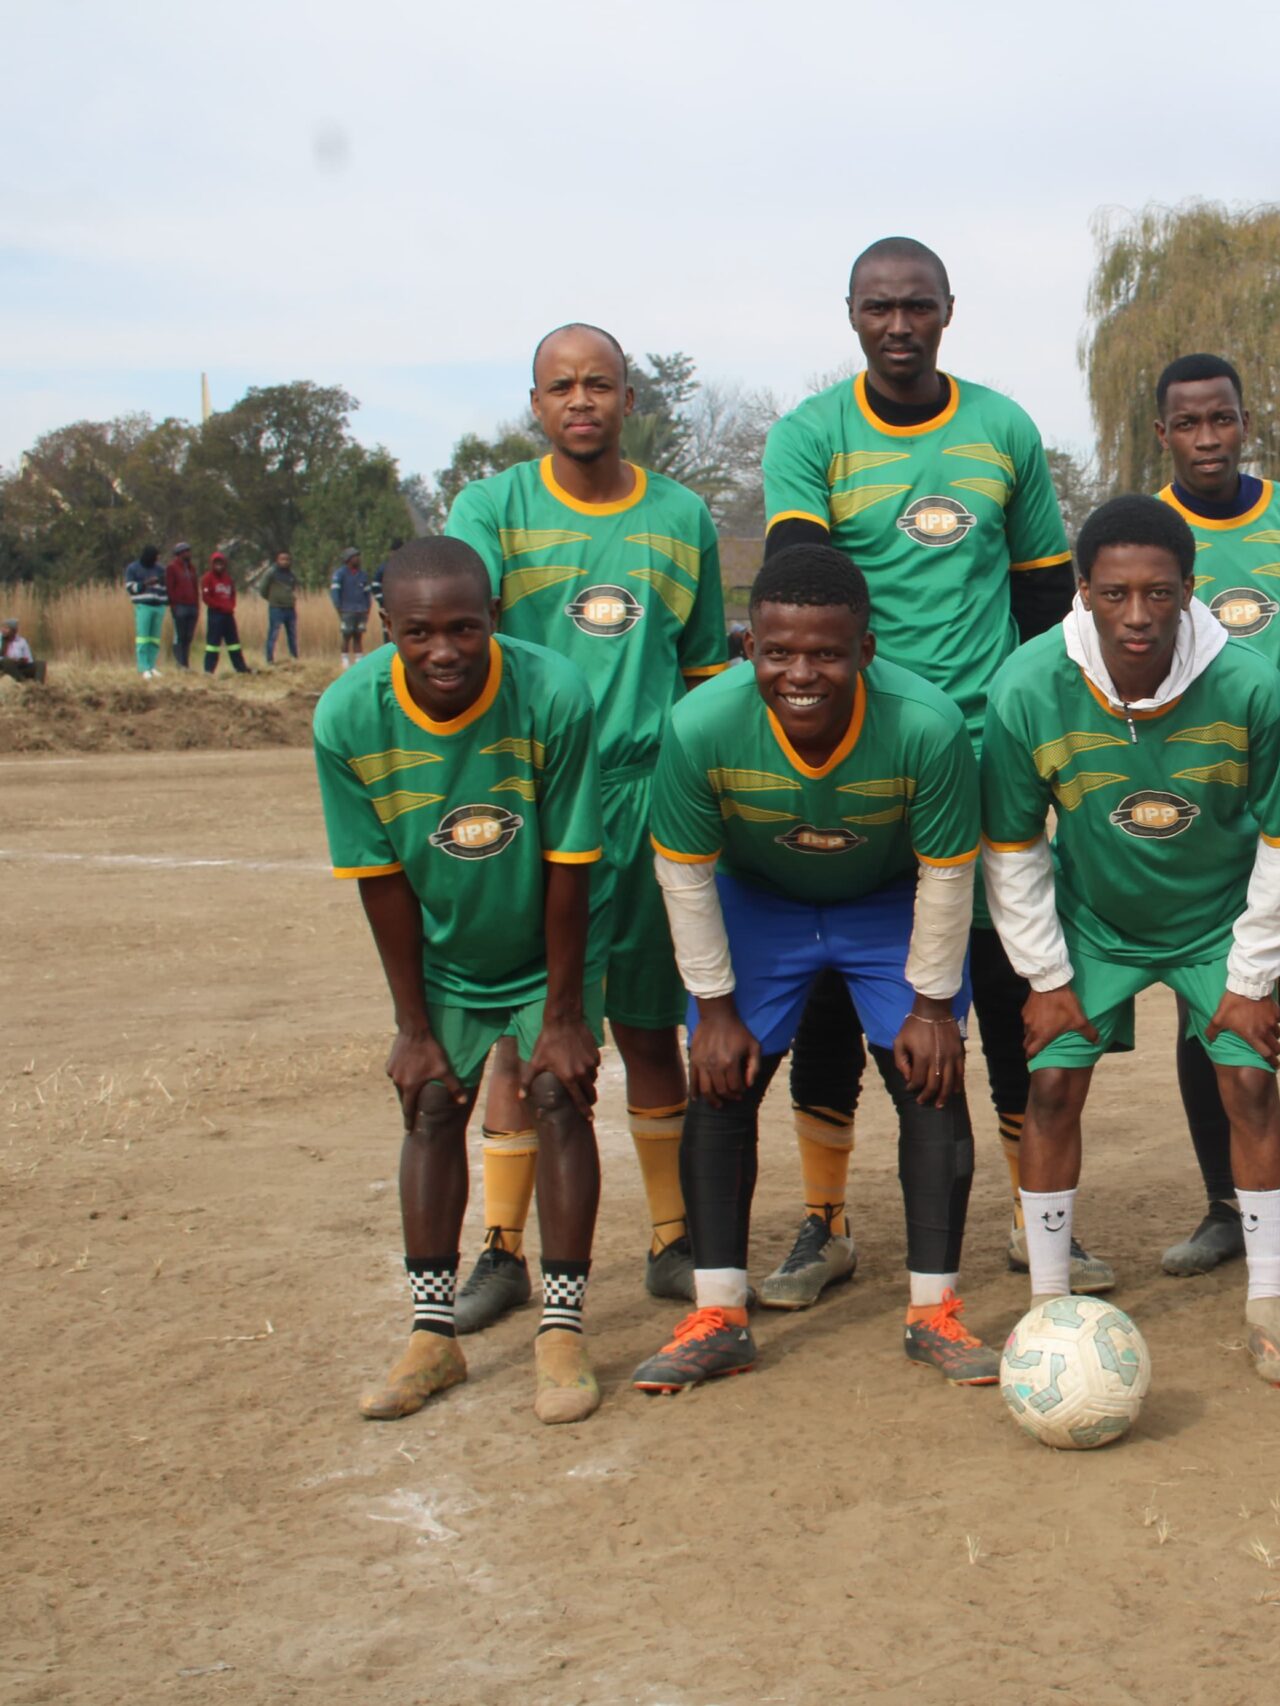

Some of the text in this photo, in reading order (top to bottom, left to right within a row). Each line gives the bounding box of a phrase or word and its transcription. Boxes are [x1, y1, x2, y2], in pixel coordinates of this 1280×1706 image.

[920, 513, 955, 530] IPP
[588, 602, 625, 621] IPP
[1223, 603, 1259, 622] IPP
[1135, 806, 1176, 823] IPP
[457, 821, 499, 843] IPP
